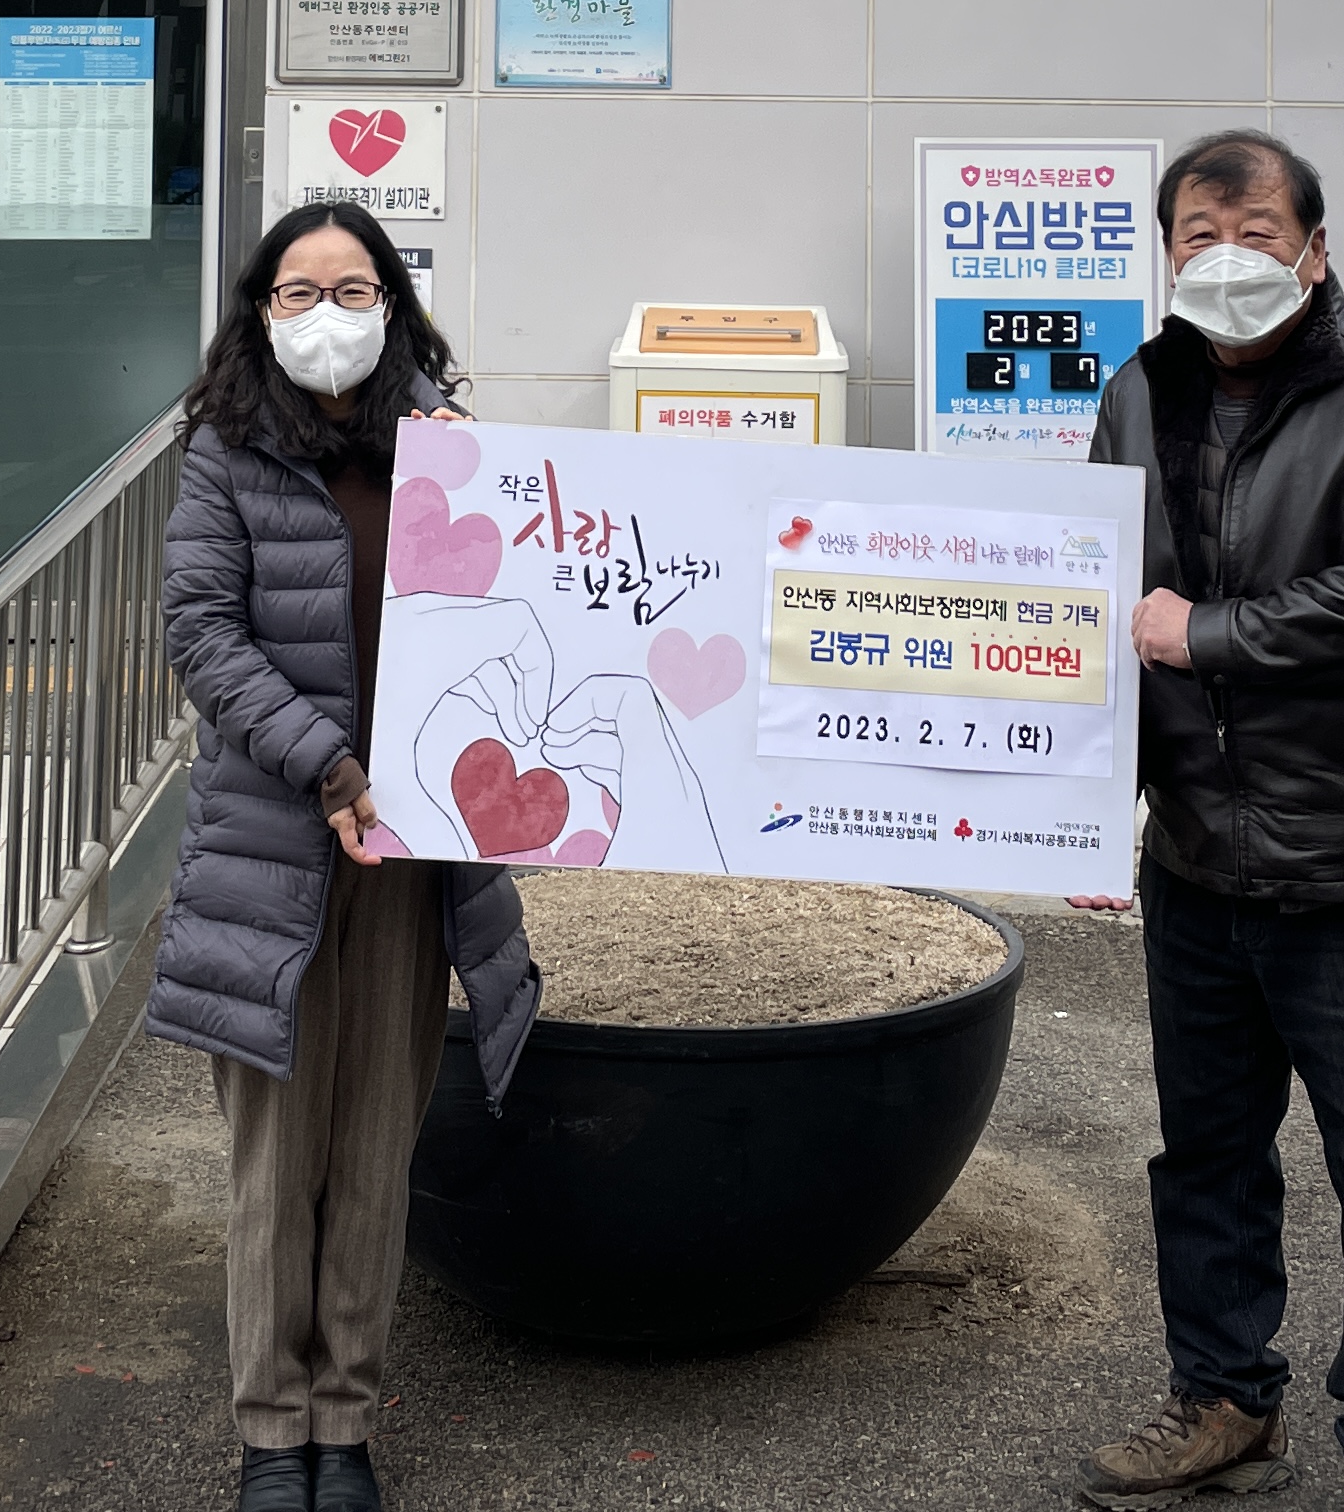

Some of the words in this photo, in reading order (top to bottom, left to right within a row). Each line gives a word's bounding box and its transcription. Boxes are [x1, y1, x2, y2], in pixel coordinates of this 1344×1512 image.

[298, 1, 343, 16] 에버그린
[346, 1, 392, 16] 환경인증
[396, 1, 441, 16] 공공기관
[329, 24, 409, 37] 안산동주민센터
[985, 167, 1093, 188] 방역소독완료
[385, 187, 430, 210] 설치기관
[943, 200, 1136, 251] 안심방문
[987, 314, 1078, 343] 2023
[1084, 320, 1096, 336] 년
[994, 357, 1011, 384] 2
[1018, 363, 1030, 379] 월
[1078, 357, 1096, 384] 7
[658, 408, 734, 428] 폐의약품
[741, 410, 797, 429] 수거함
[950, 398, 1021, 414] 방역소독을
[498, 473, 544, 503] 작은
[513, 458, 622, 559] 사랑
[818, 532, 859, 555] 안산동
[940, 534, 977, 564] 사업
[981, 542, 1010, 564] 나눔
[1014, 544, 1054, 568] 릴레이
[552, 563, 576, 592] 큰
[656, 552, 721, 590] 나누기
[782, 585, 837, 612] 안산동
[846, 589, 1008, 622] 지역사회보장협의체
[1016, 600, 1054, 624] 현금
[1062, 603, 1101, 627] 기탁
[809, 629, 891, 666] 김봉규
[903, 637, 953, 670] 위원
[970, 641, 1081, 678] 100만원
[816, 712, 901, 743] 2023.
[918, 720, 944, 746] 2.
[963, 722, 988, 748] 7.
[1006, 722, 1054, 755] (화)
[808, 821, 839, 835] 안산동
[843, 823, 937, 841] 지역사회보장협의체
[976, 829, 998, 843] 경기
